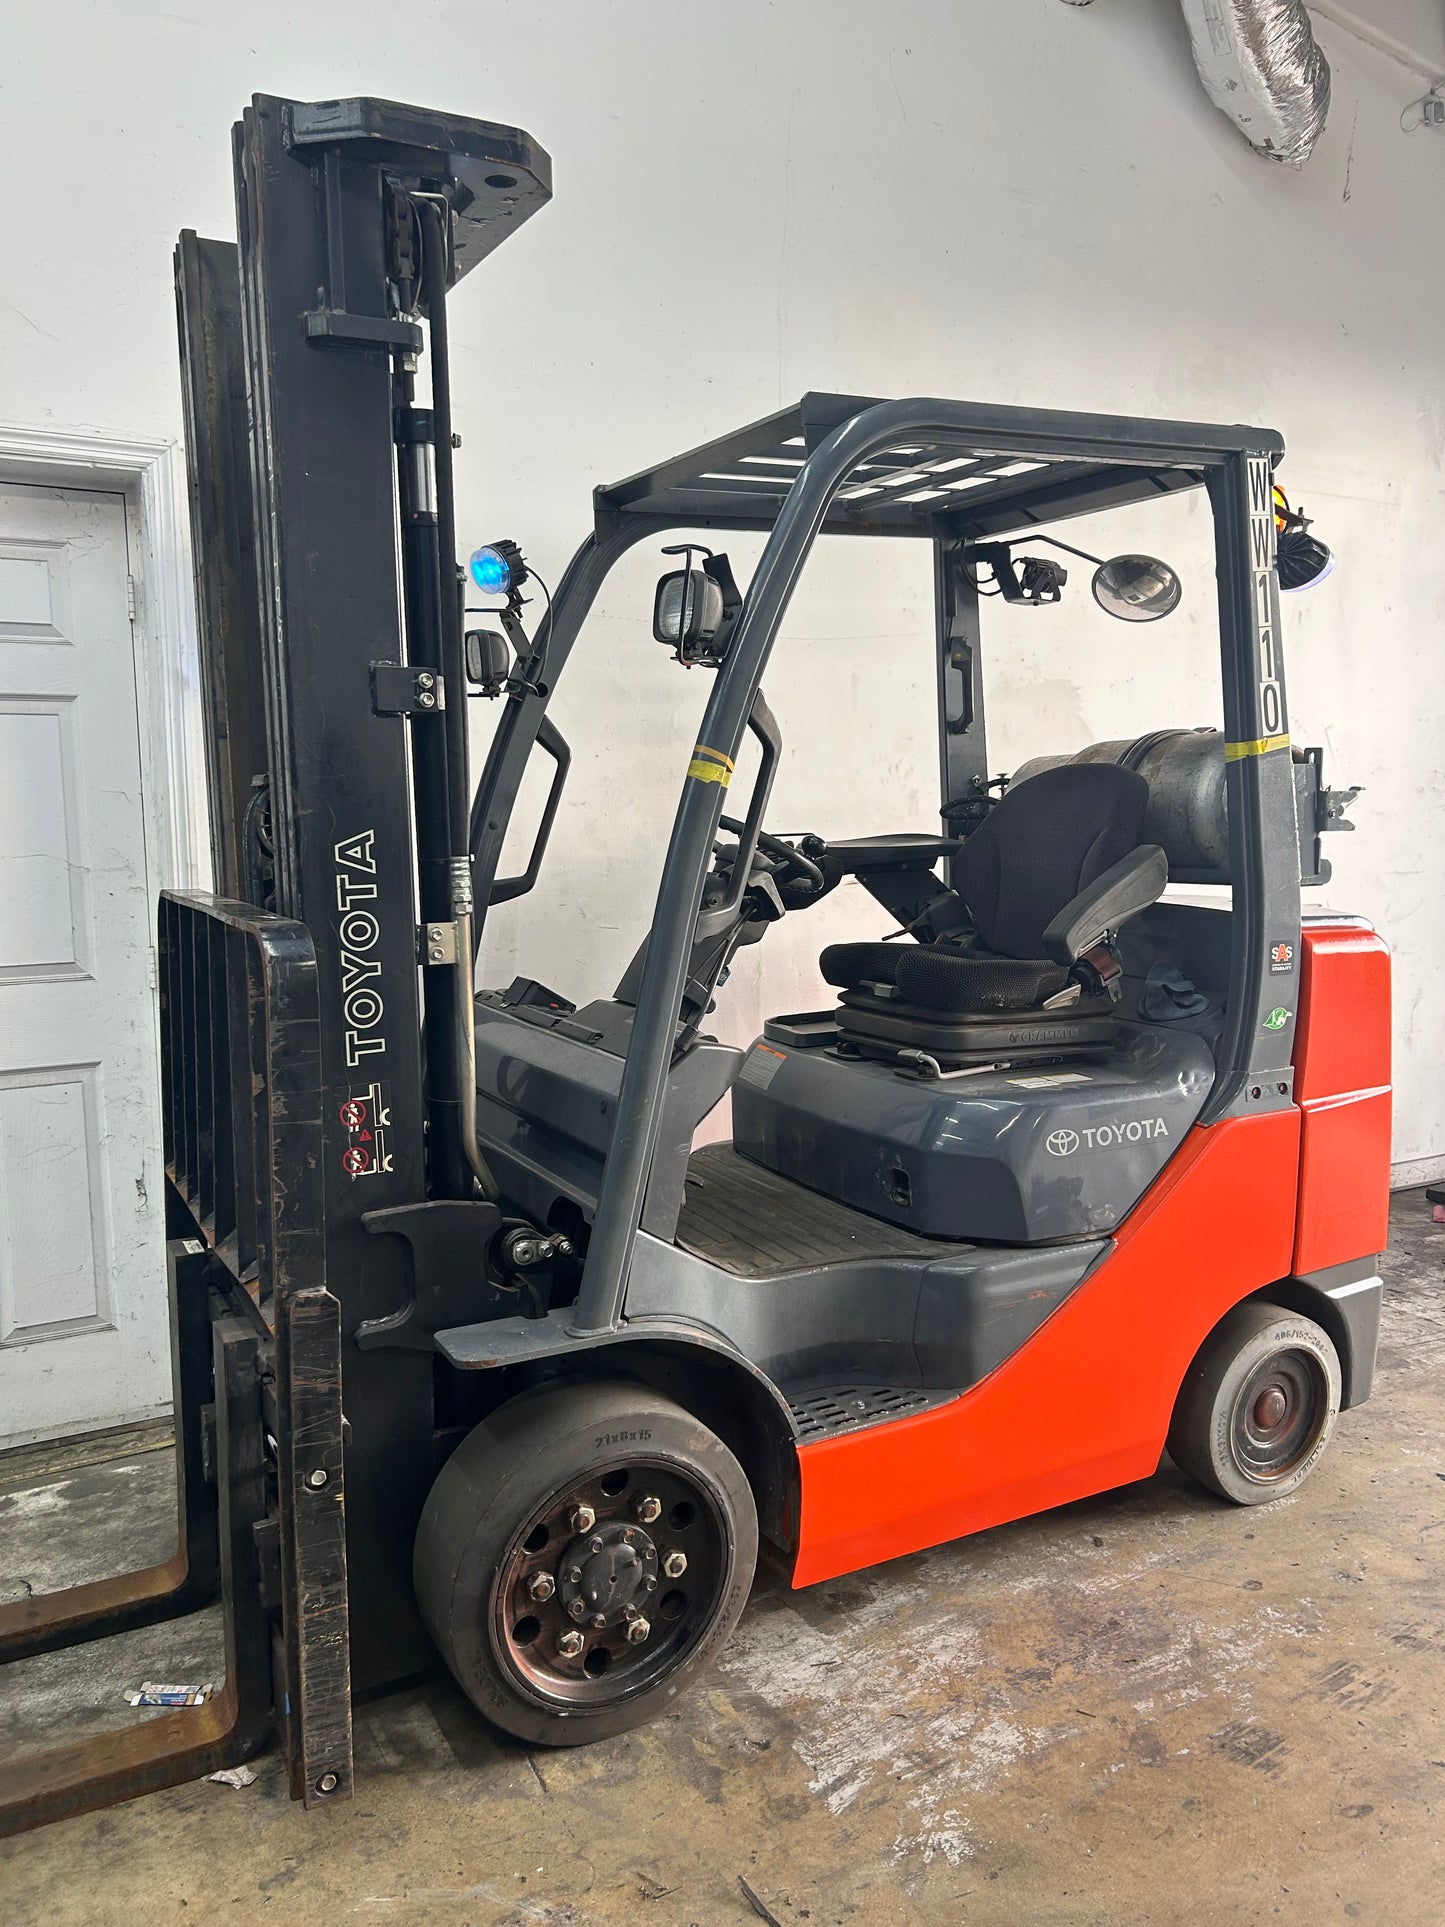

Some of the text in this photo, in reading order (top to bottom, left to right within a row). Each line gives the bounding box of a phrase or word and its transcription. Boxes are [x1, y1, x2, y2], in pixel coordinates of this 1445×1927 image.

[334, 829, 386, 1067] TOYOTA
[1271, 943, 1293, 962] SAS
[1082, 1117, 1169, 1148] TOYOTA
